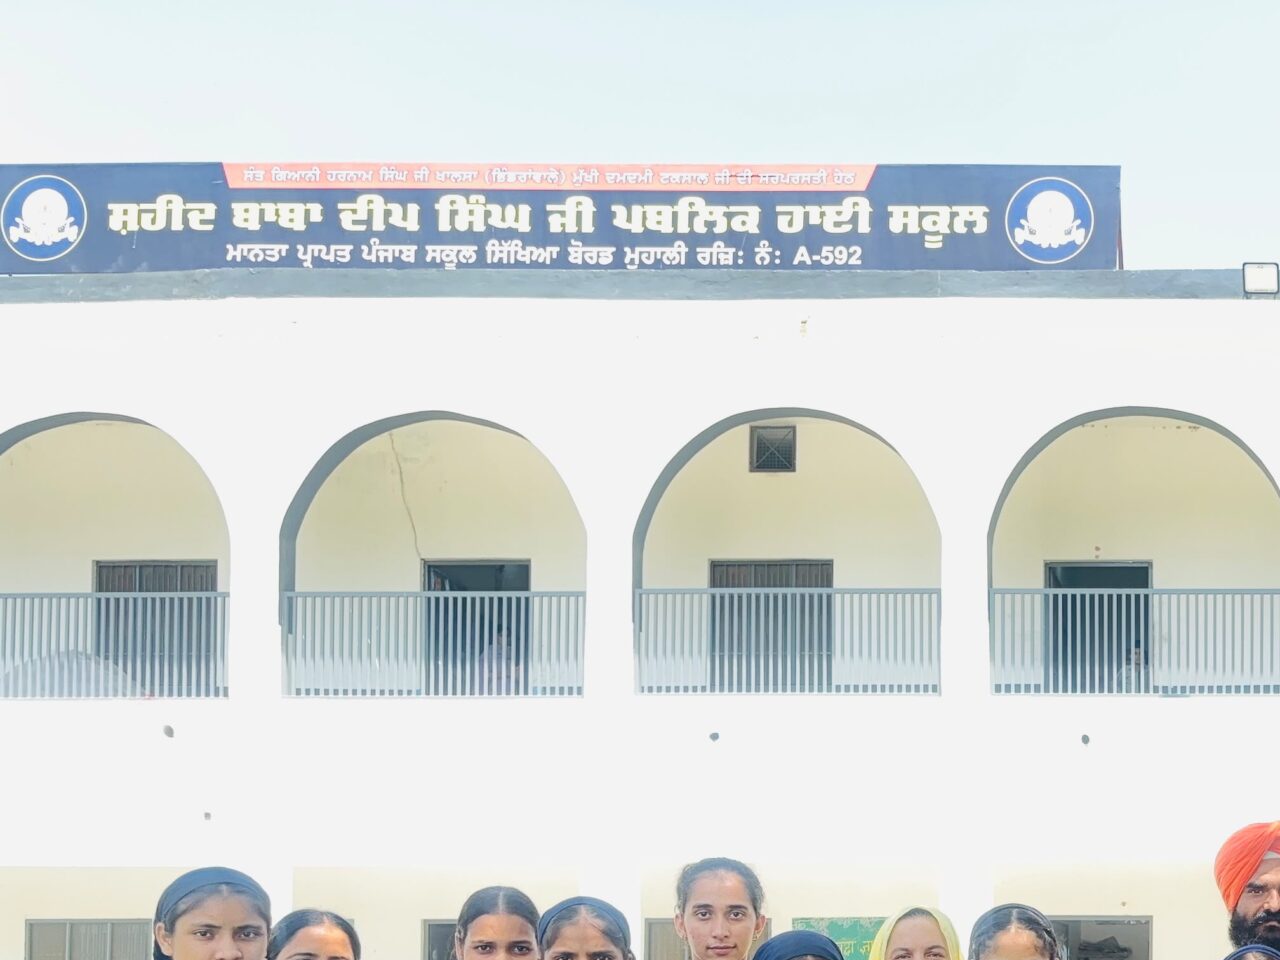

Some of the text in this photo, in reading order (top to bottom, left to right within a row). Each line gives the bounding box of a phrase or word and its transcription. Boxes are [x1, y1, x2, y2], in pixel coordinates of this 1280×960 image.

[244, 167, 264, 182] ਸੰਤ
[271, 166, 320, 182] ਗਿਆਨੀ
[327, 171, 372, 182] ਹਰਨਾਮ
[380, 167, 408, 182] ਸਿੰਘ
[413, 168, 430, 183] ਜੀ
[435, 170, 479, 183] ਖਾਲਸਾ
[605, 168, 654, 184] ਦਮਦਮੀ
[660, 170, 709, 185] ਟਕਸਾਲ
[736, 168, 752, 185] ਦੀ
[759, 168, 829, 185] ਸਰਪਰਸਤੀ
[832, 169, 856, 185] ਹੇਠ
[107, 194, 990, 249] ਸ਼ਹੀਦ ਬਾਬਾ ਦੀਪ ਸਿੰਘ ਜੀ ਪਬਲਿਕ ਹਾਈ ਸਕੂਲ
[225, 243, 289, 263] ਮਾਨਤਾ
[296, 243, 353, 269] ਪ੍ਰਾਪਤ
[361, 237, 418, 263] ਪੰਜਾਬ
[425, 243, 478, 271] ਸਕੂਲ
[485, 238, 560, 264] ਸਿੱਖਿਆ
[567, 238, 617, 265] ਬੋਰਡ
[623, 240, 689, 269] ਮੁਹਾਲੀ
[792, 245, 863, 265] A-592
